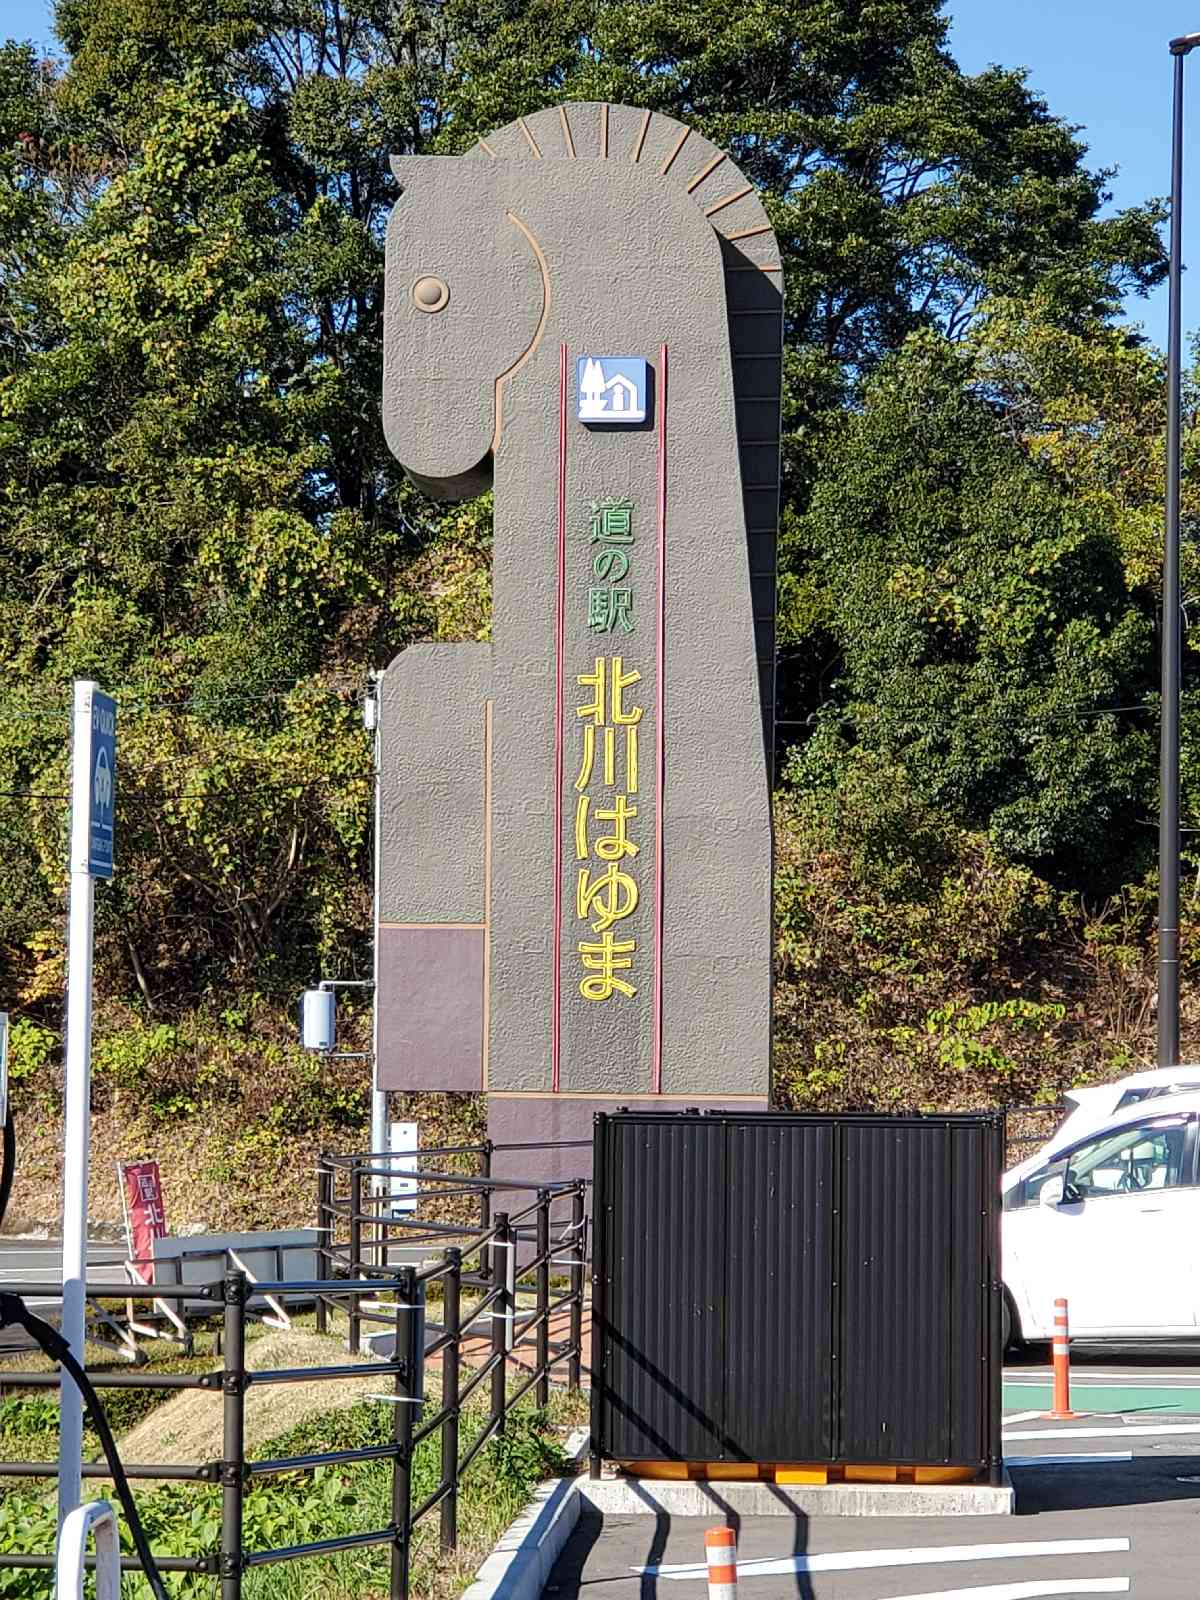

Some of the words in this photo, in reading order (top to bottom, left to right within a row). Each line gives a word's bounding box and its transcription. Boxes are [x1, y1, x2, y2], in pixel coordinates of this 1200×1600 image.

[587, 496, 636, 633] 道の駅
[574, 656, 643, 1001] 北川はゆま
